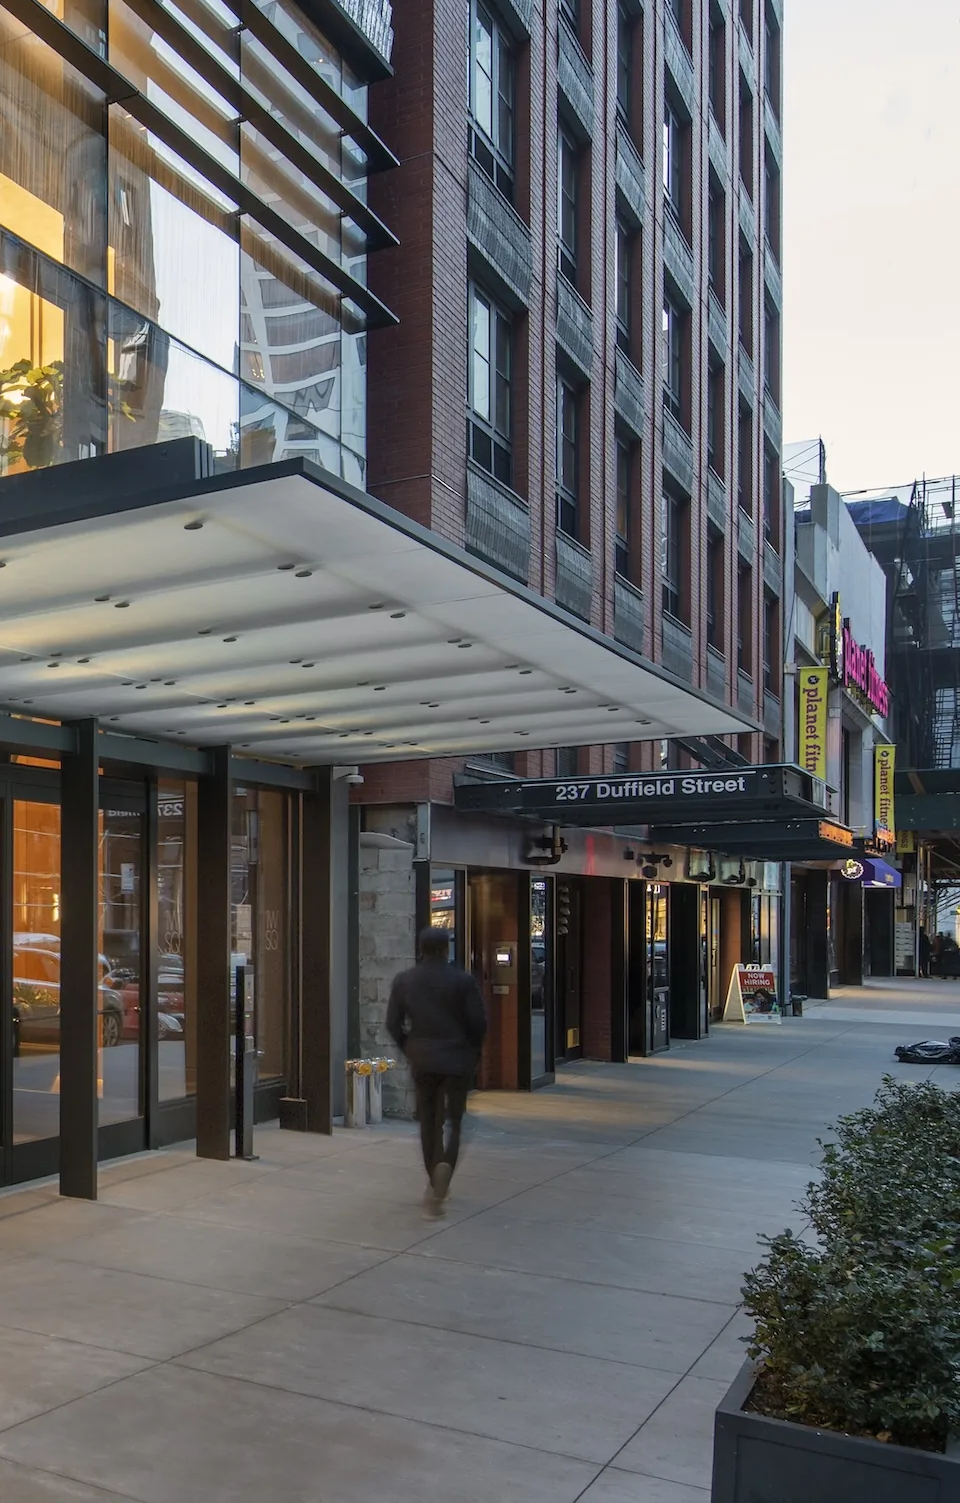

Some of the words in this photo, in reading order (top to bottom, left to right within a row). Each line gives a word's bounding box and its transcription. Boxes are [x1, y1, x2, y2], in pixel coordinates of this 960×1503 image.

[803, 687, 822, 739] planet
[806, 744, 821, 772] fitn
[555, 784, 590, 800] 237
[596, 779, 675, 798] Duffield
[681, 776, 746, 794] Street
[878, 759, 891, 794] planet
